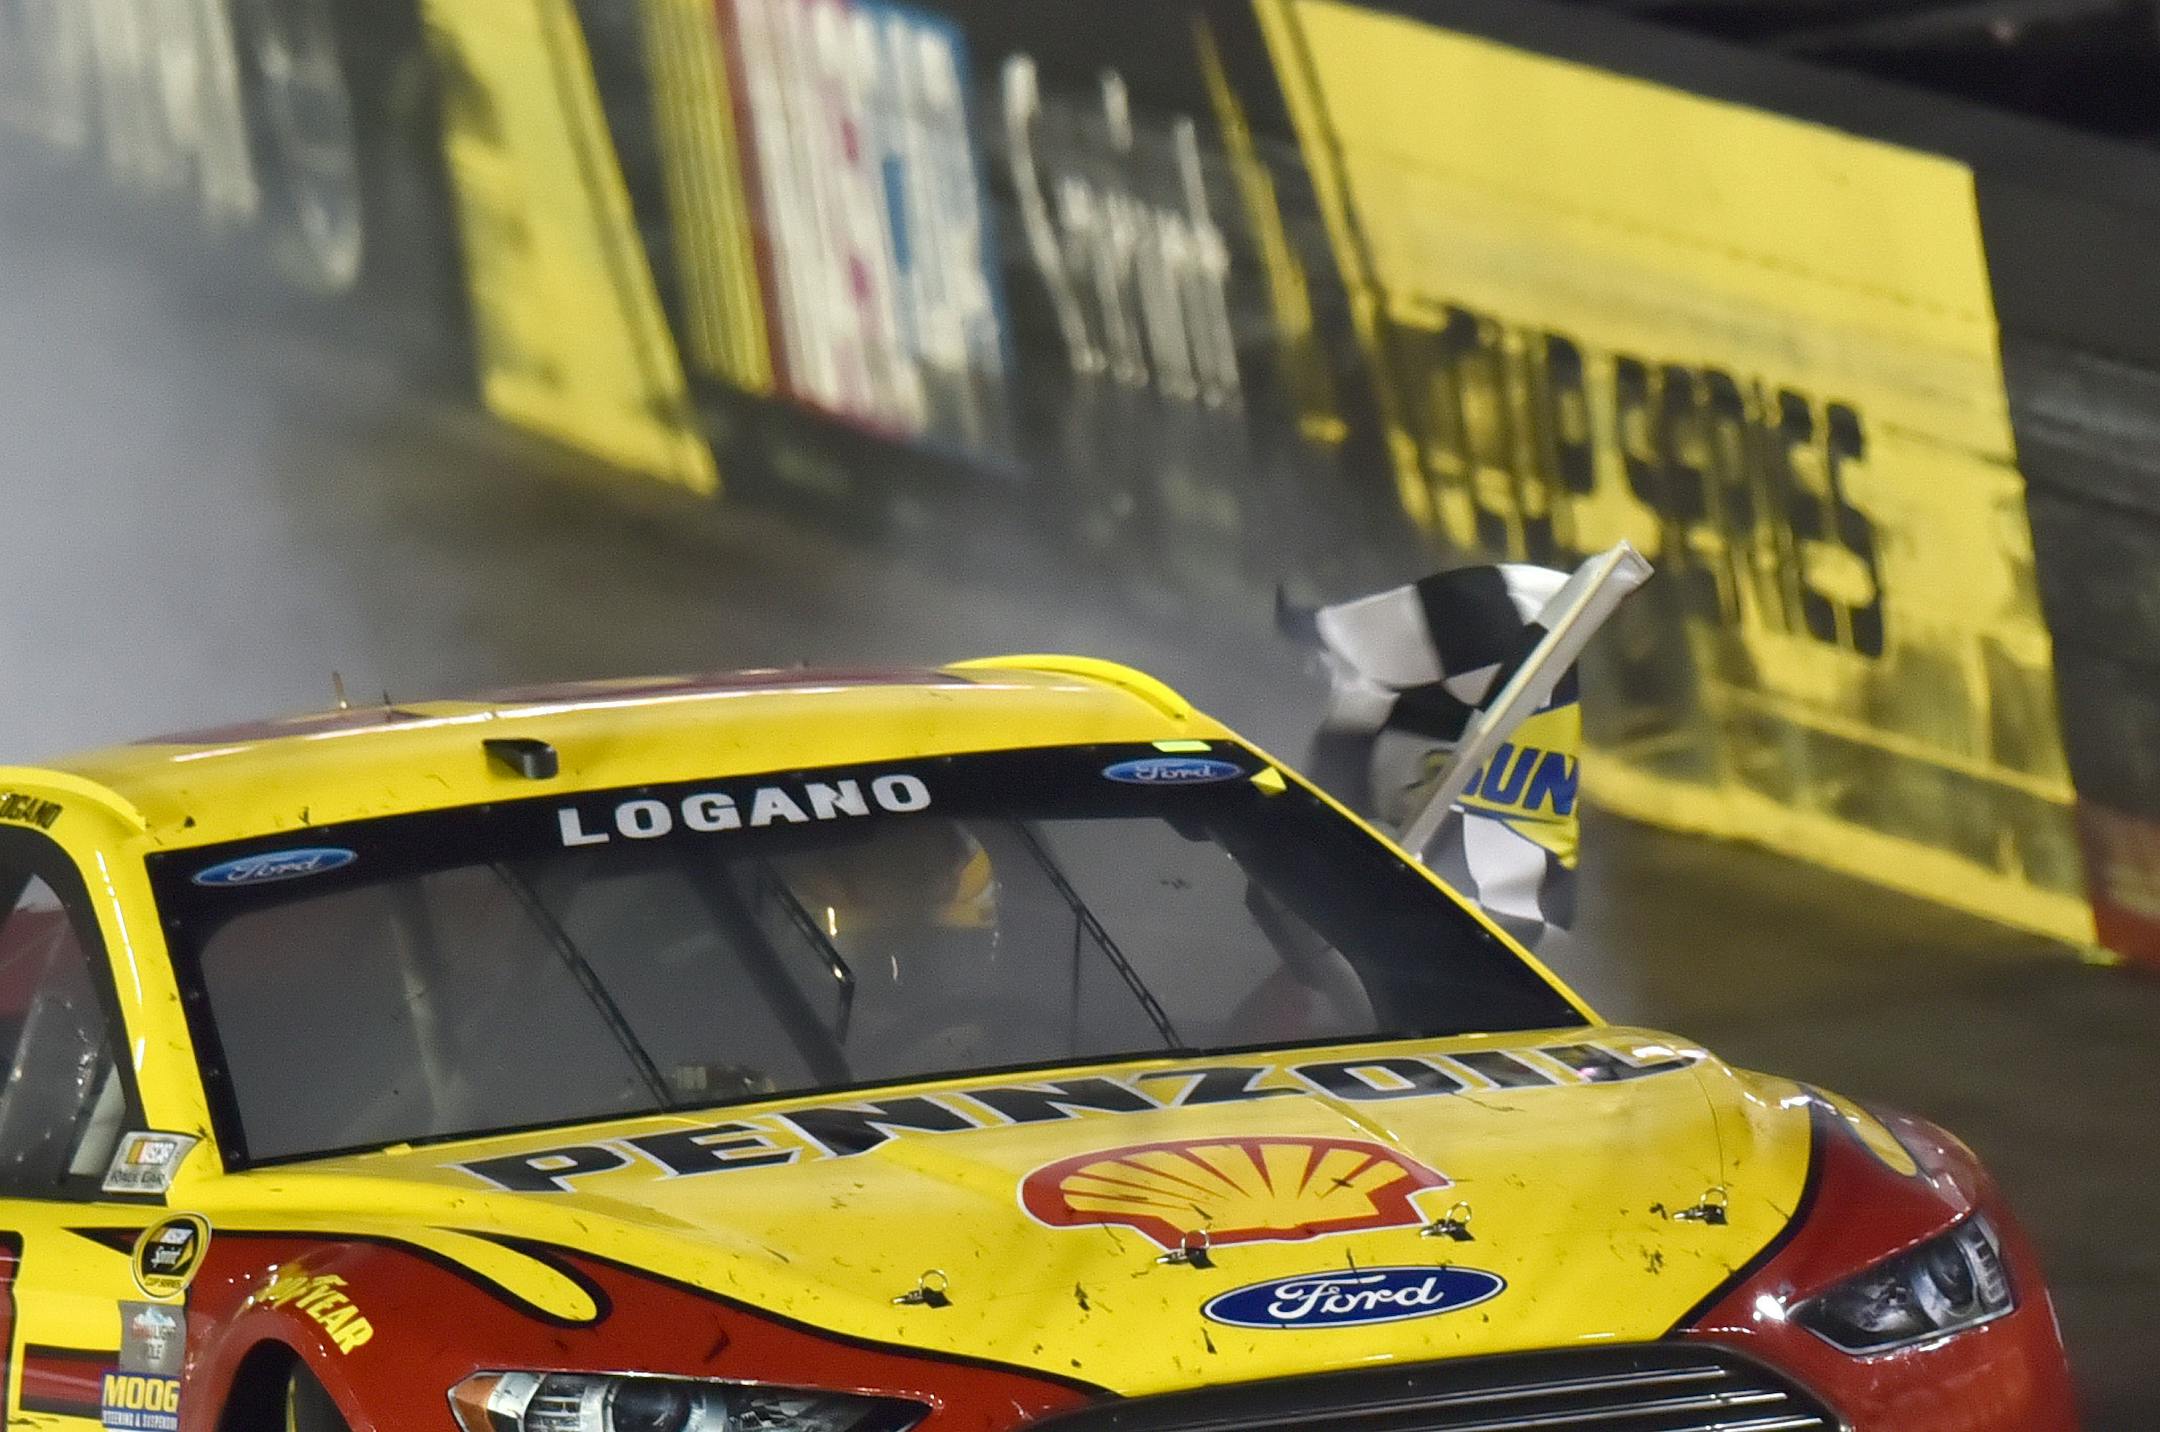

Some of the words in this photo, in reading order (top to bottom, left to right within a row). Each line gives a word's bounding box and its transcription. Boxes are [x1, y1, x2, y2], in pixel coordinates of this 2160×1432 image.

[1133, 758, 1215, 781] Ford
[558, 774, 932, 847] LOGANO
[224, 850, 325, 884] Ford
[455, 1040, 1708, 1196] PENNZOIL
[1268, 1274, 1445, 1320] Ford
[102, 1374, 181, 1413] MOOG
